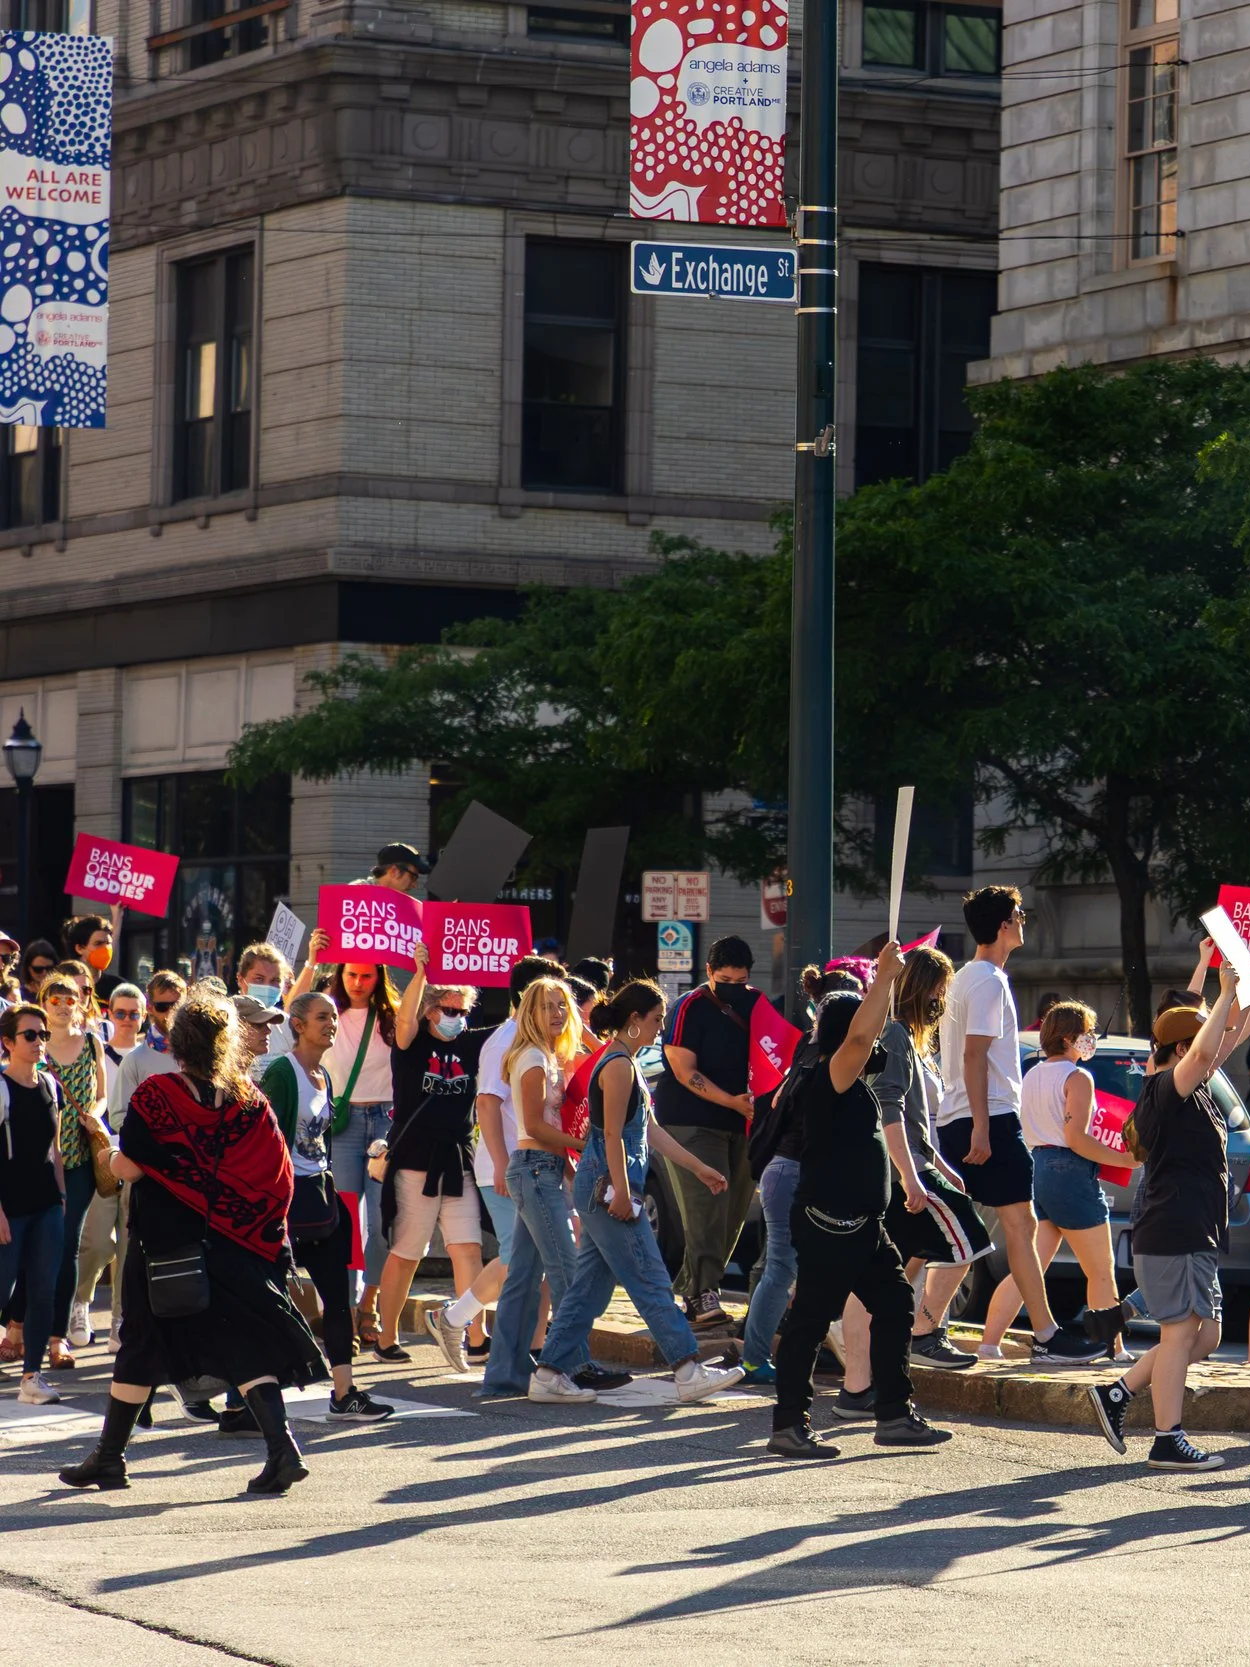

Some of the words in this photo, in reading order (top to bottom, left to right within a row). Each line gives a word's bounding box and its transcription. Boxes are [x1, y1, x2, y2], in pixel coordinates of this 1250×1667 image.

[689, 59, 733, 74] angela
[737, 61, 781, 74] adams
[713, 86, 764, 97] CREATIVE
[713, 96, 772, 107] PORTLAND
[27, 169, 60, 185] ALL
[65, 172, 102, 187] ARE
[6, 186, 102, 204] WELCOME
[671, 251, 769, 296] Exchange
[777, 258, 790, 278] St
[90, 847, 133, 871] BANS
[86, 861, 118, 879] OFF
[118, 869, 156, 890] OUR
[652, 876, 666, 885] NO
[686, 877, 699, 886] NO
[83, 873, 146, 901] BODIES
[645, 886, 673, 895] PARKING
[678, 887, 708, 897] PARKING
[342, 899, 397, 920] BANS
[340, 915, 382, 933] OFF
[384, 919, 423, 943] OUR
[444, 917, 491, 937] BANS
[341, 932, 416, 959] BODIES
[442, 935, 476, 953] OFF
[477, 937, 519, 955] OUR
[442, 953, 511, 973] BODIES
[421, 1076, 470, 1095] RESIST
[568, 1097, 588, 1138] bortion
[1092, 1125, 1123, 1150] OUR
